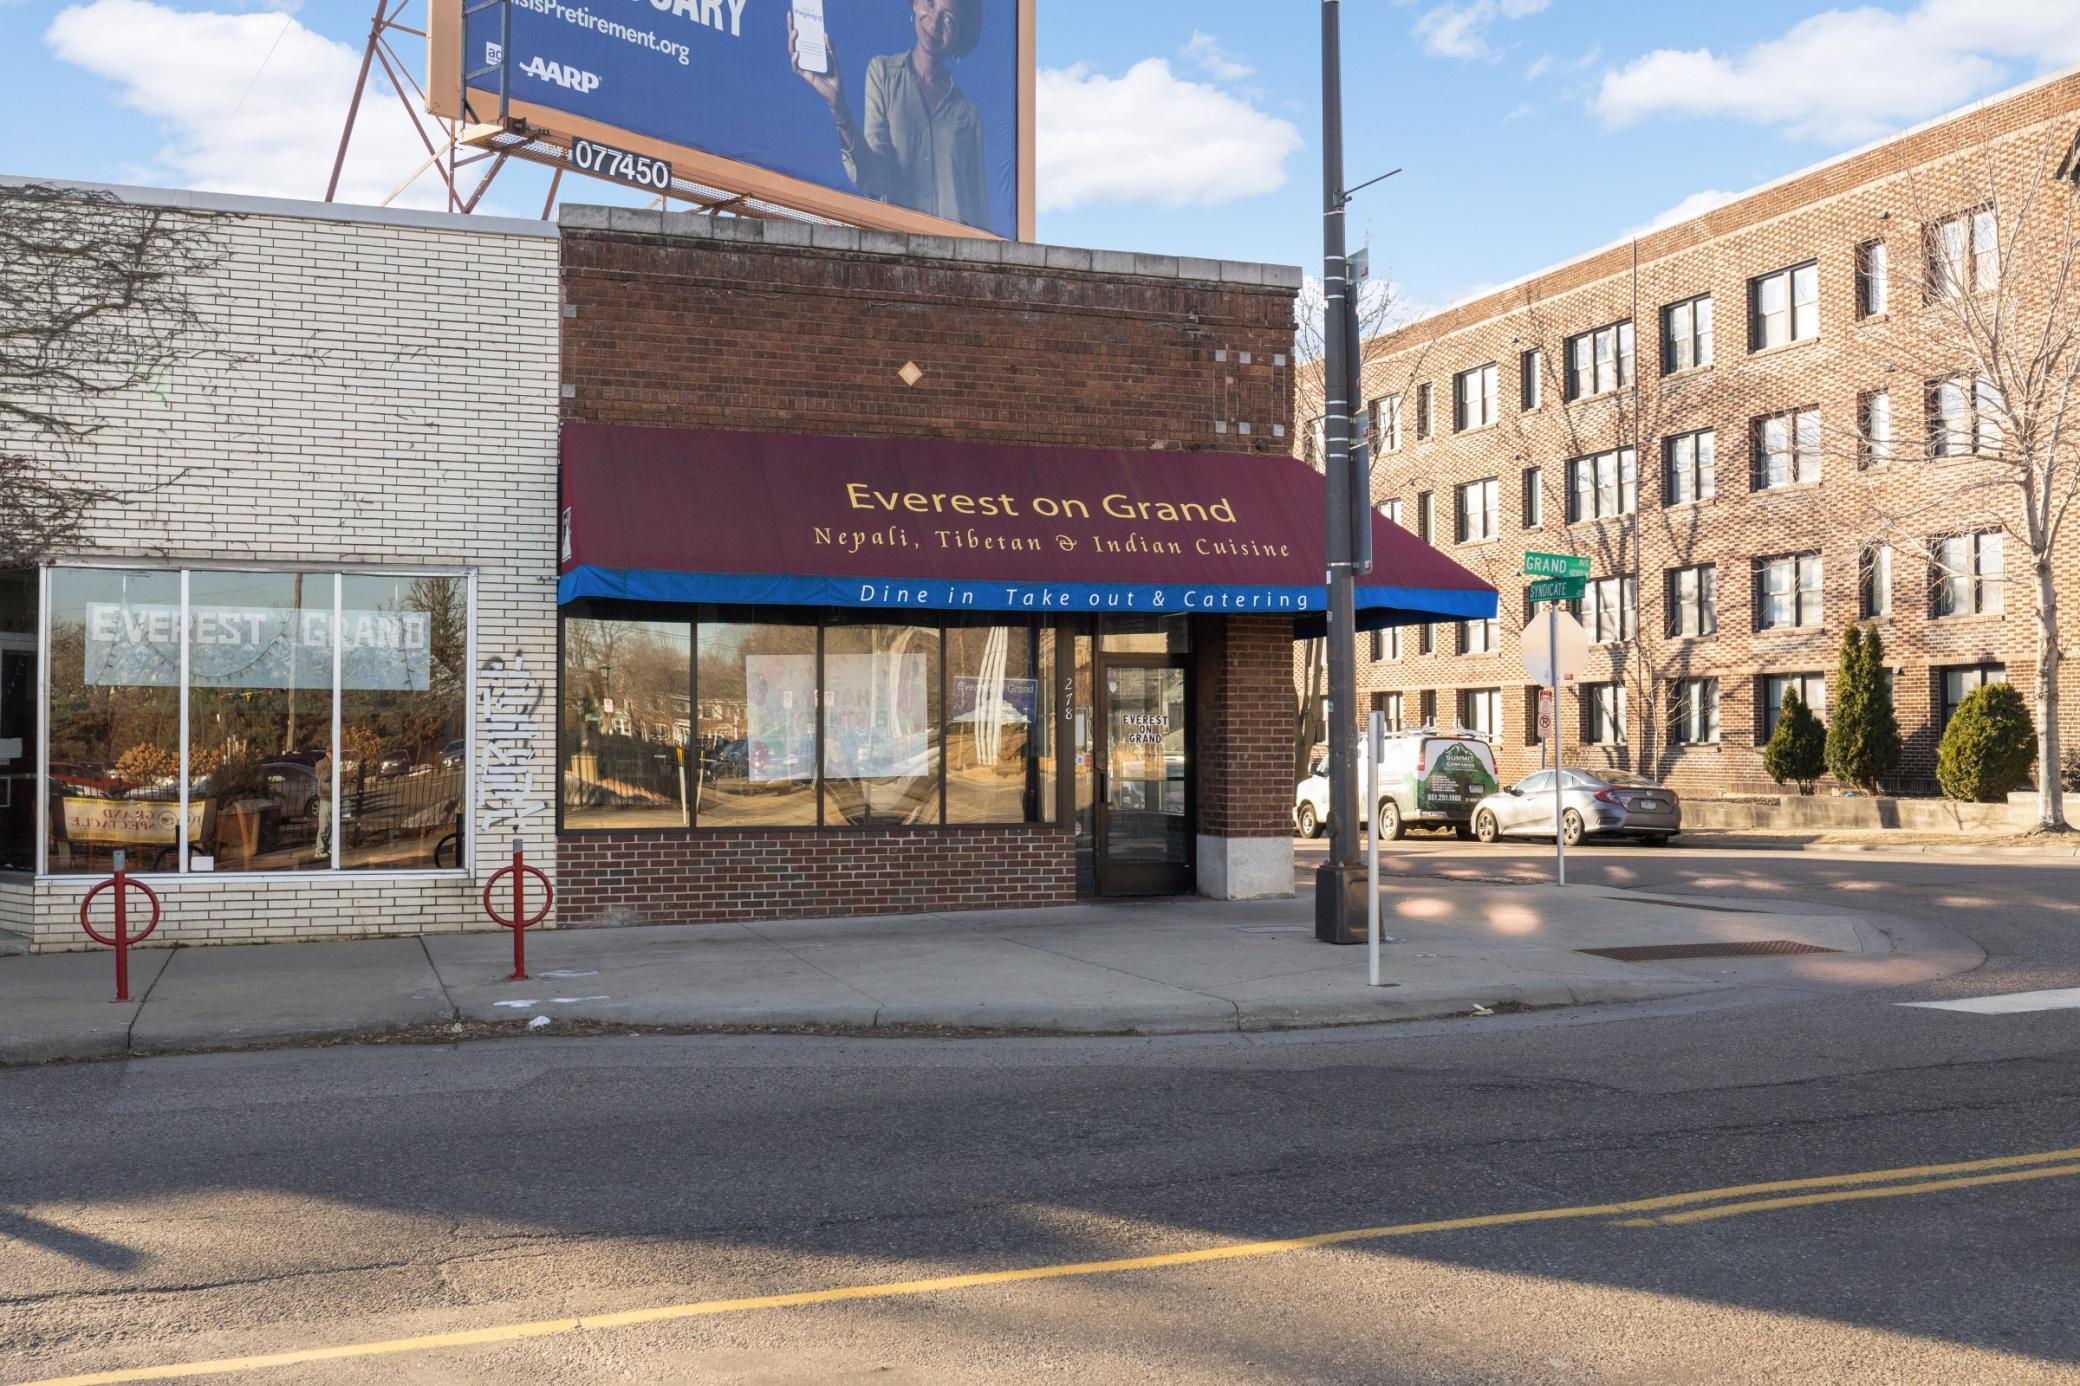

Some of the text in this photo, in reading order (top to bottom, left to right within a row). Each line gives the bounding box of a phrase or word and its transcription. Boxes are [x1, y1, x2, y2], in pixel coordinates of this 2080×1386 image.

[519, 56, 600, 94] AARP
[576, 141, 668, 188] 077450
[846, 483, 1237, 523] Everest on Grand
[813, 526, 1290, 558] Nepali, Tibetan & Indian Cuisine
[1527, 557, 1567, 573] GRAND
[860, 585, 1308, 611] Dine in Take out & Catering
[1530, 582, 1567, 598] SYNDICATE
[92, 604, 424, 648] EVEREST GRAND
[1007, 684, 1034, 694] Grand
[1065, 677, 1073, 720] 278
[1123, 714, 1168, 725] EVEREST
[1139, 725, 1152, 734] ON
[1129, 734, 1162, 744] GRAND
